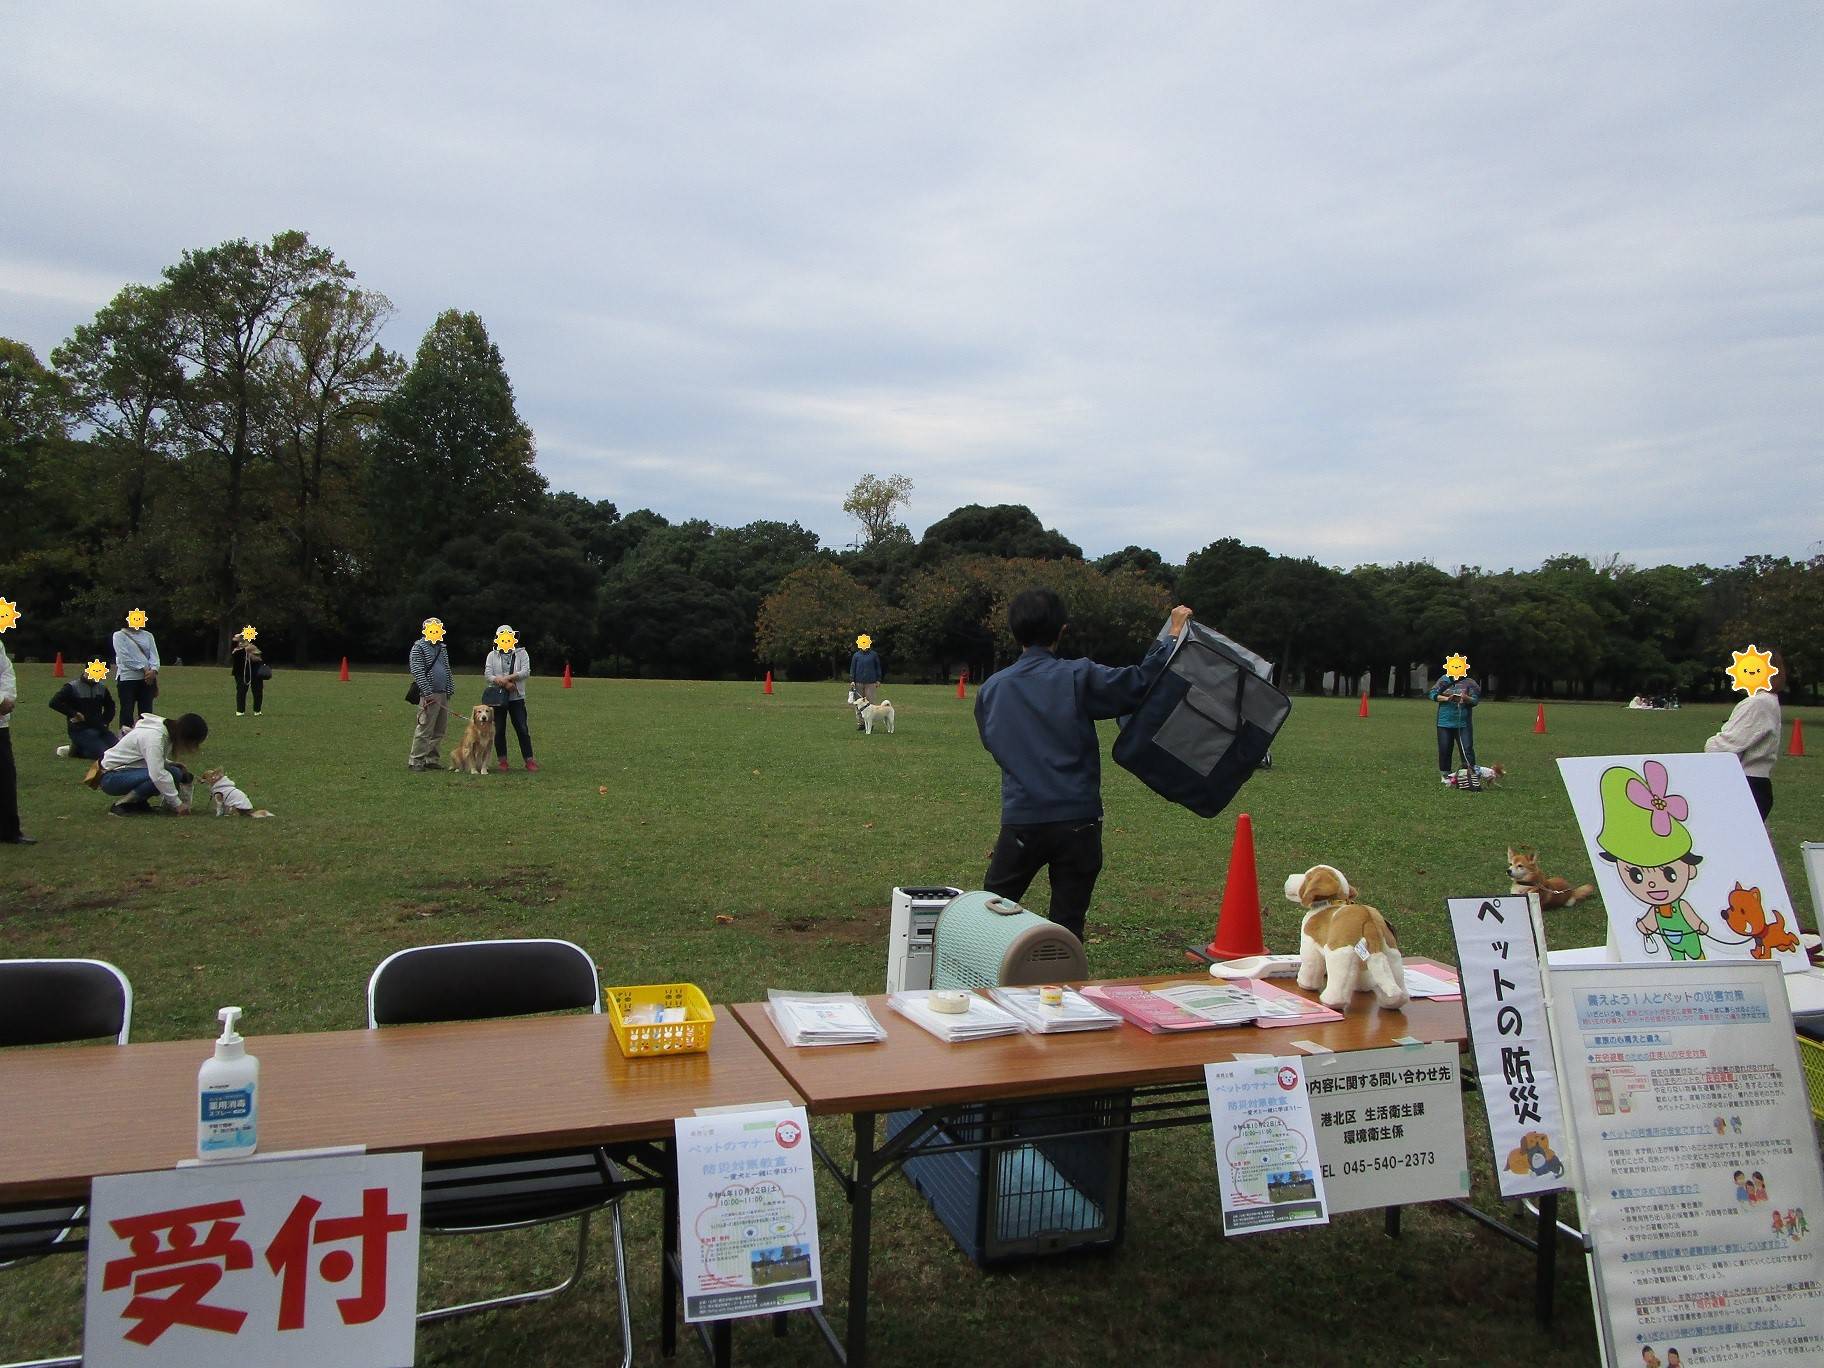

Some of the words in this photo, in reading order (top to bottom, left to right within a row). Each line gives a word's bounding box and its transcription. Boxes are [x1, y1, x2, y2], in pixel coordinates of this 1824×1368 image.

[1476, 896, 1541, 1126] ペットの防災
[1306, 1065, 1452, 1095] 内容に関する問い合わせ先
[1320, 1109, 1357, 1128] 港北区
[1364, 1102, 1425, 1122] 生活衛生課
[688, 1137, 775, 1153] ペットのマナー
[1343, 1124, 1405, 1145] 環境衛生係
[1343, 1151, 1436, 1175] 045-540-2373
[102, 1187, 409, 1346] 受付
